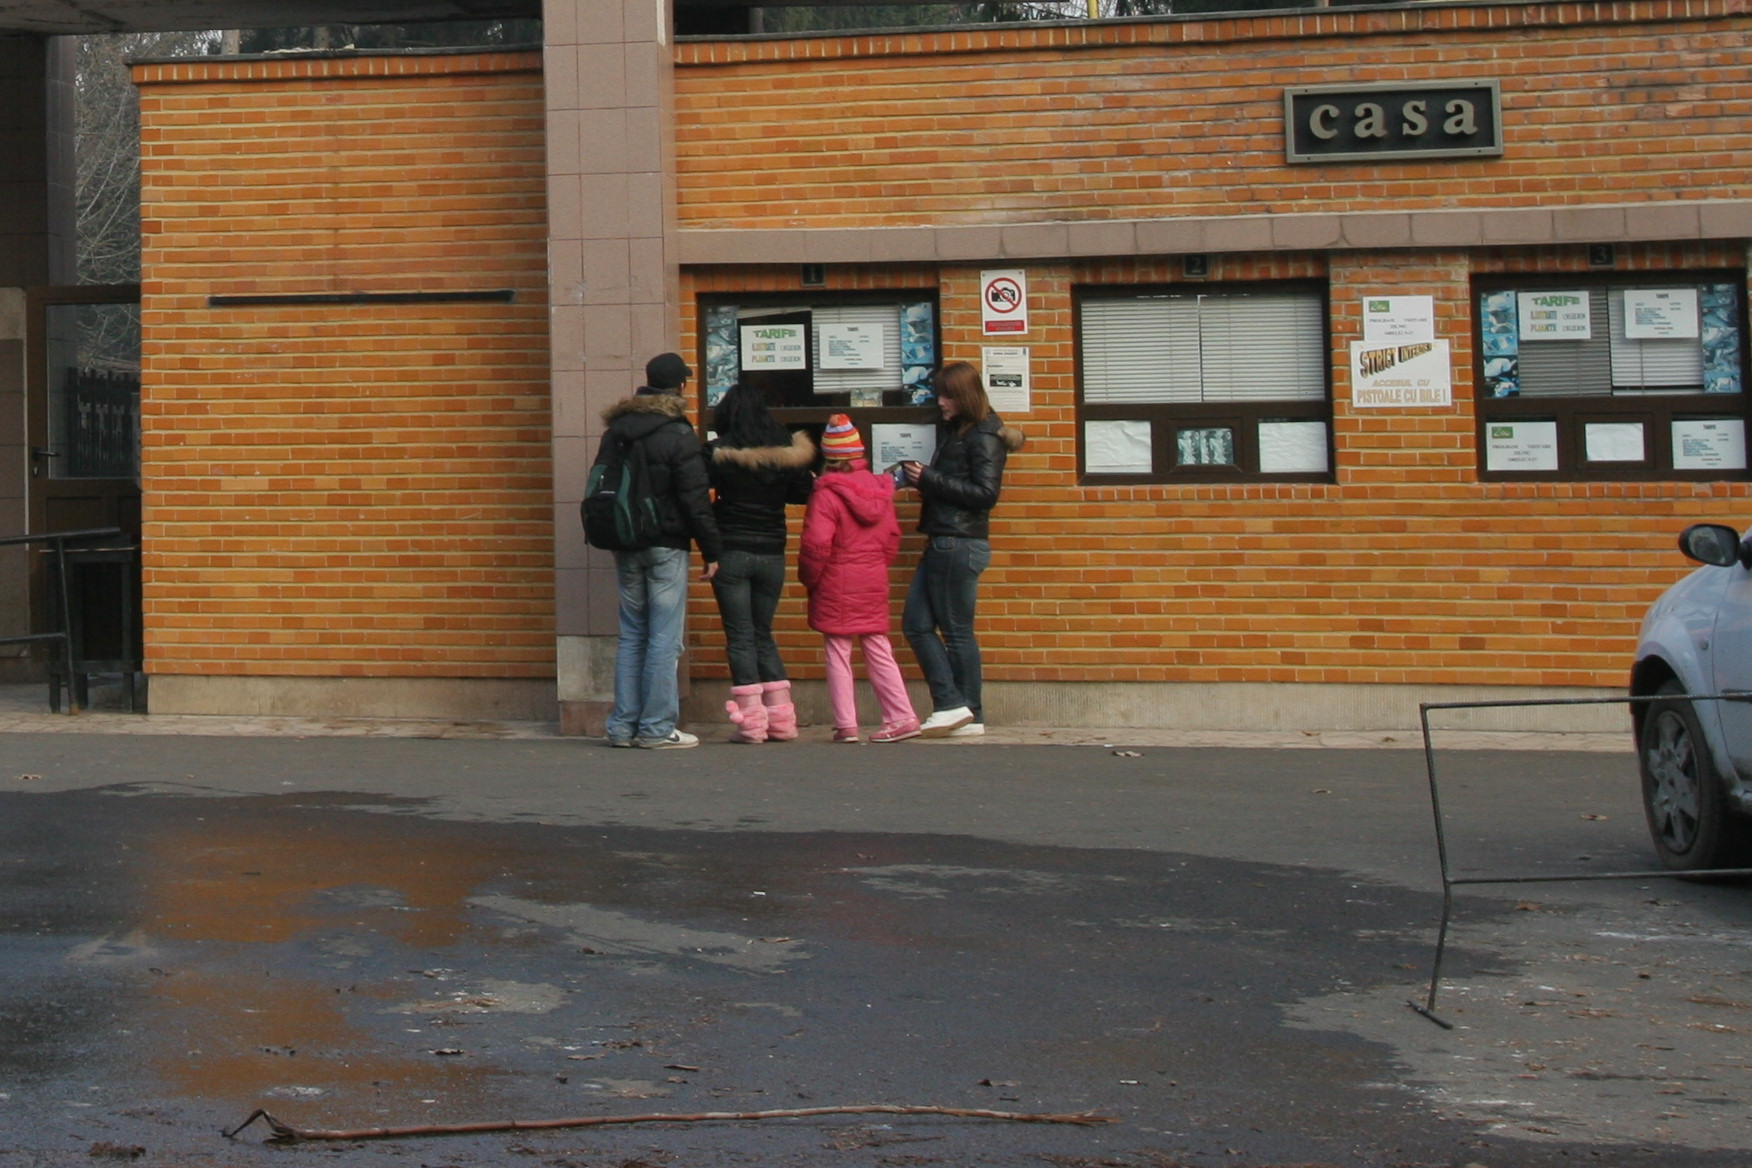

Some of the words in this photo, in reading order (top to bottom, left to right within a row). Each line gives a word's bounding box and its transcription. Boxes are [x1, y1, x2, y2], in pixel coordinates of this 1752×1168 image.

[1309, 96, 1478, 139] casa
[753, 328, 797, 339] TARIFE
[1360, 347, 1396, 378] STRICT
